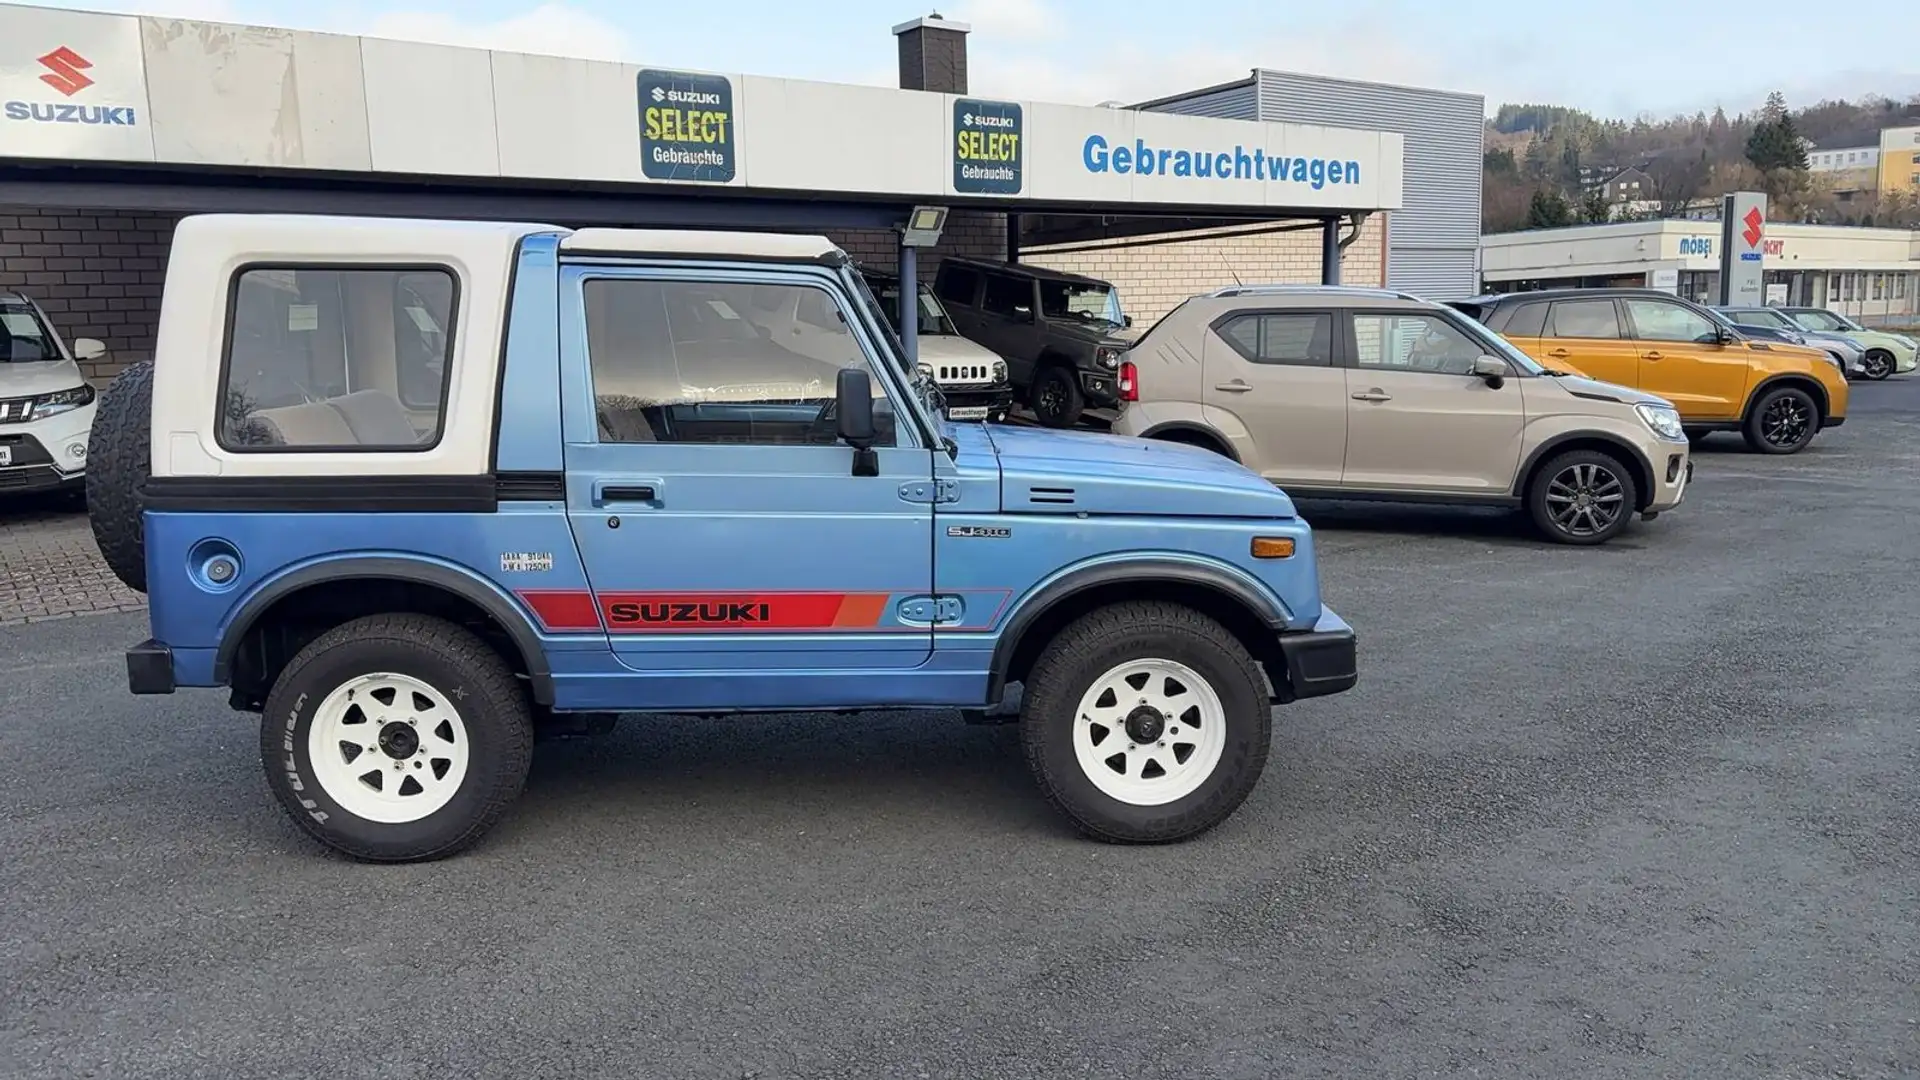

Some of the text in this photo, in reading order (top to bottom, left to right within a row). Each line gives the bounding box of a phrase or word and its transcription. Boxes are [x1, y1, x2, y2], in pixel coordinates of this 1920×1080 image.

[667, 91, 720, 104] SUZUKI
[5, 101, 135, 125] SUZUKI
[975, 116, 1013, 127] SUZUKI
[645, 106, 727, 144] SELECT
[958, 130, 1018, 161] SELECT
[653, 146, 723, 165] Gebrauchte
[1083, 135, 1360, 190] Gebrauchtwagen
[962, 165, 1013, 180] Gebrauchte
[1680, 236, 1712, 254] MÖBEL
[610, 603, 770, 622] SUZUKI
